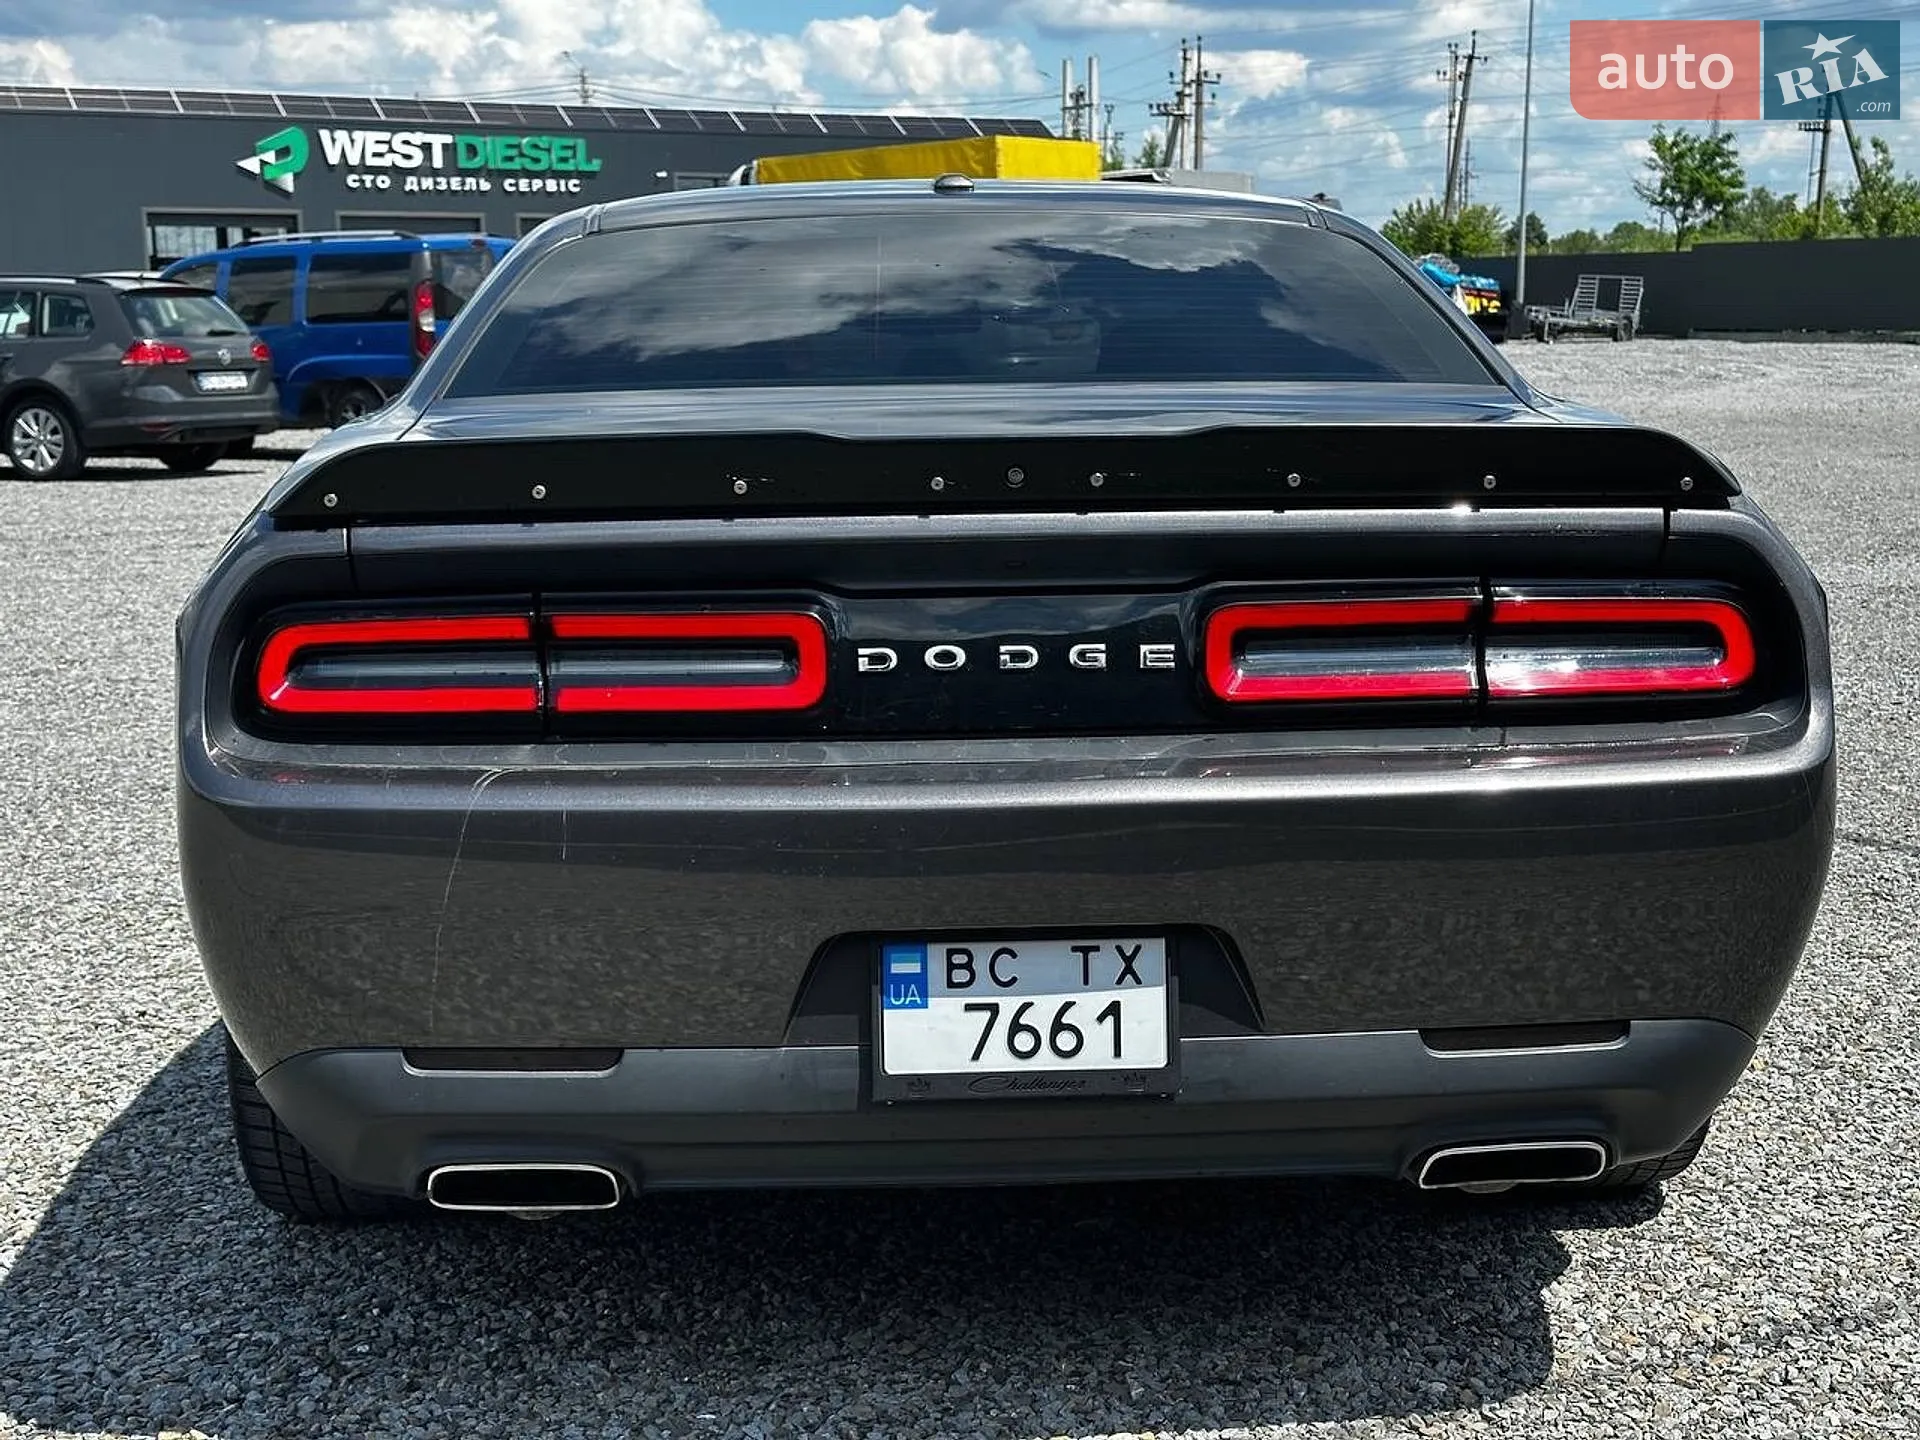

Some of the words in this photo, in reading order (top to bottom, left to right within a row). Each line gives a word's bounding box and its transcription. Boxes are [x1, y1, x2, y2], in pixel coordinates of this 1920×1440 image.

[346, 173, 391, 190] СТО
[403, 175, 492, 193] ДИЗЕЛЬ
[502, 177, 582, 194] СЕРВІС
[857, 643, 1176, 672] DODGE
[945, 947, 1019, 990] BC
[1070, 944, 1144, 986] TX
[889, 984, 922, 1006] UA
[963, 999, 1123, 1062] 7661
